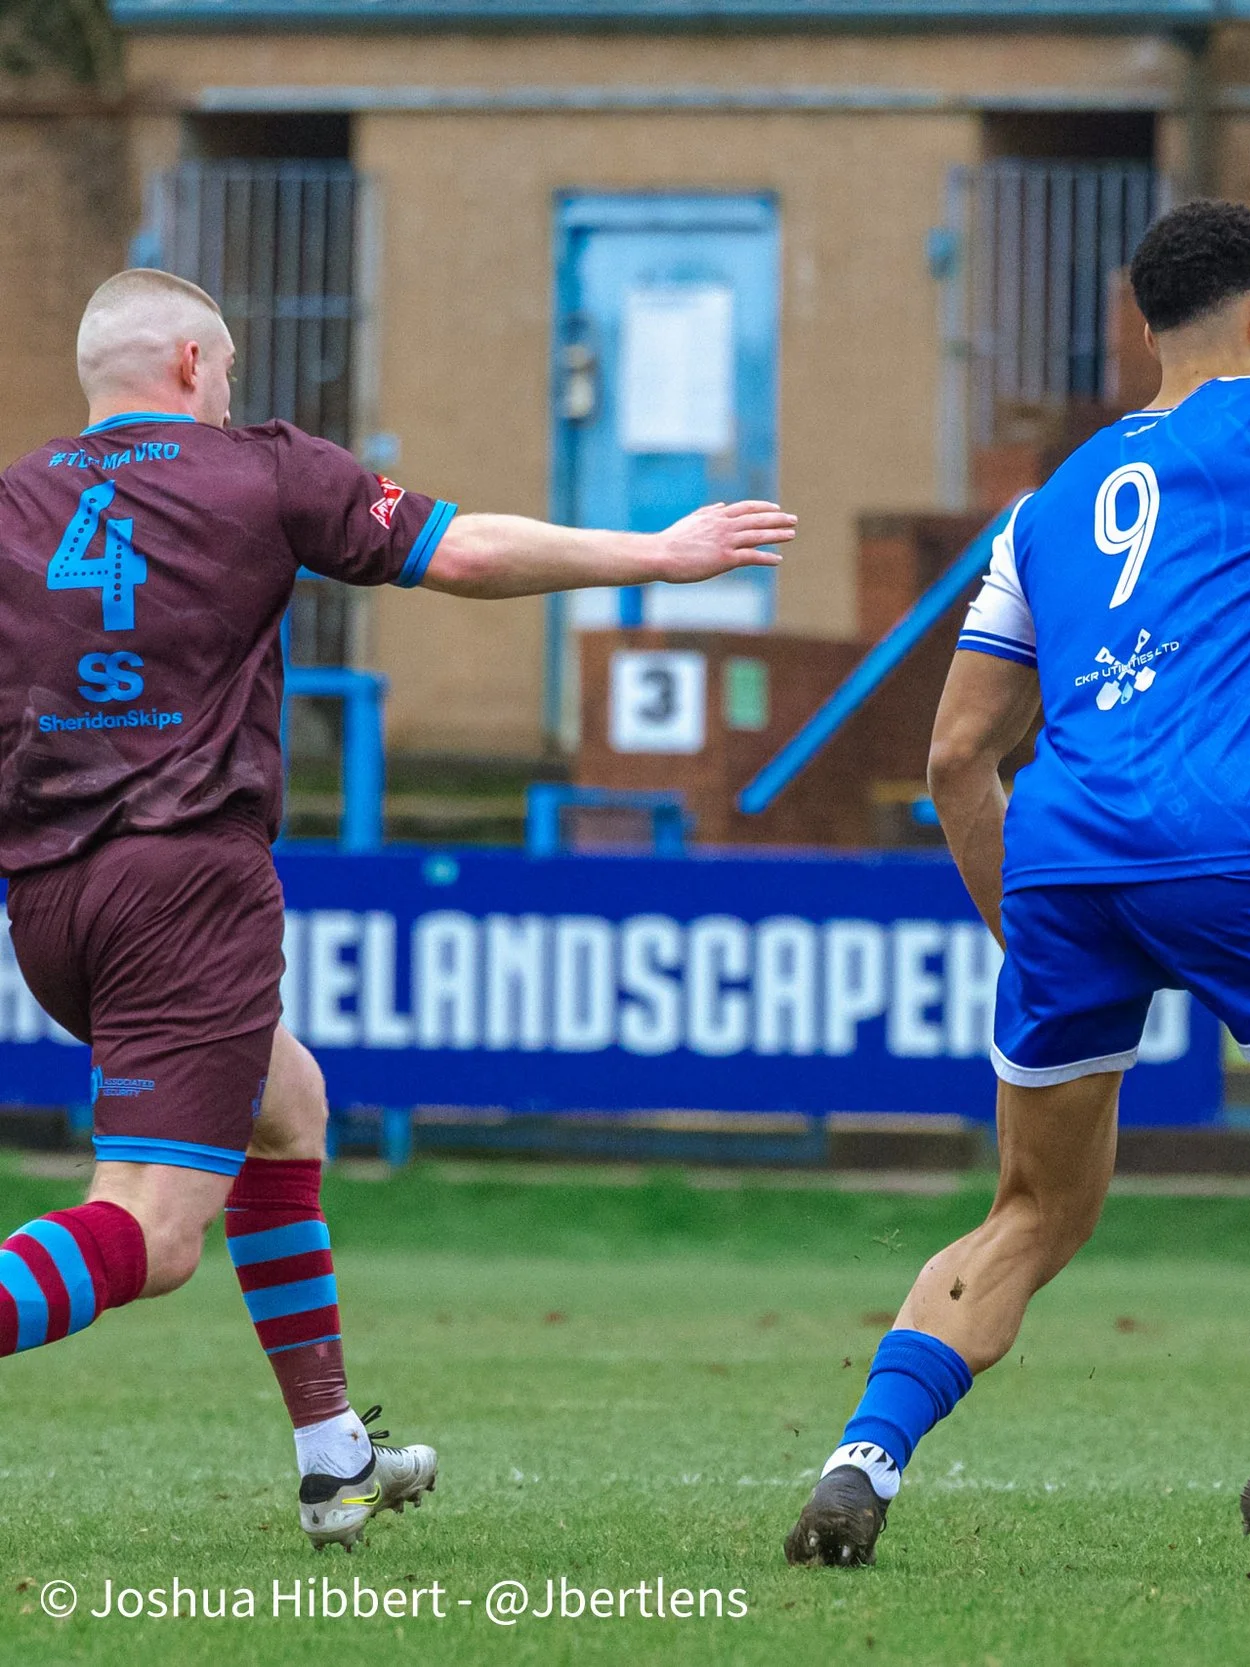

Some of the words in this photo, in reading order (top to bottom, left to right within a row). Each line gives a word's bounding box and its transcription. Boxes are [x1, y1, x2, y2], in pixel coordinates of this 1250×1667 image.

[48, 442, 181, 470] #TMAVRO
[46, 479, 148, 632] 4
[1094, 462, 1161, 609] 9
[77, 651, 144, 703] SS
[1074, 671, 1100, 687] CKR
[1154, 641, 1180, 656] LTD
[38, 708, 183, 733] SheridanSkips
[637, 668, 679, 725] 3
